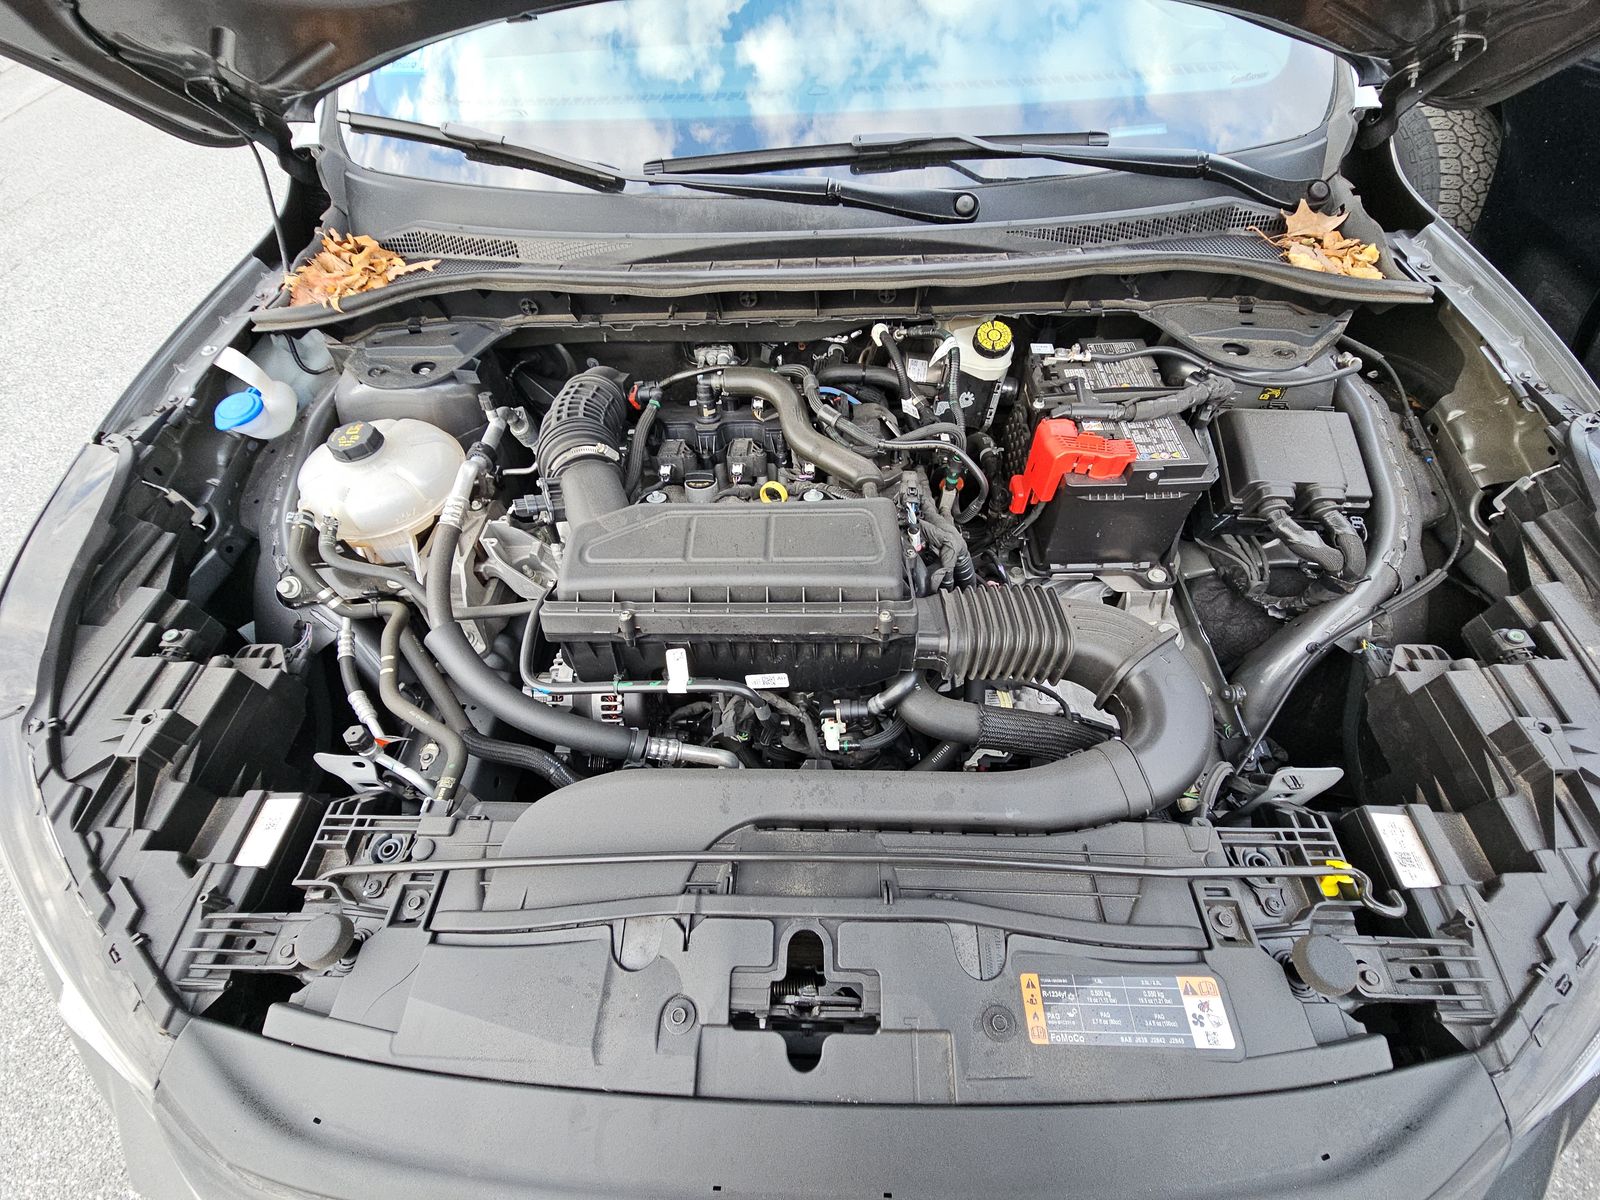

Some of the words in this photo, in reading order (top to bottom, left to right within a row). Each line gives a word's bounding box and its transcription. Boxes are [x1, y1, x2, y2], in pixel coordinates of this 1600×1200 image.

[1042, 990, 1067, 999] R-1234yf
[1047, 1012, 1060, 1020] PAG
[1051, 1033, 1085, 1042] FoMoCo
